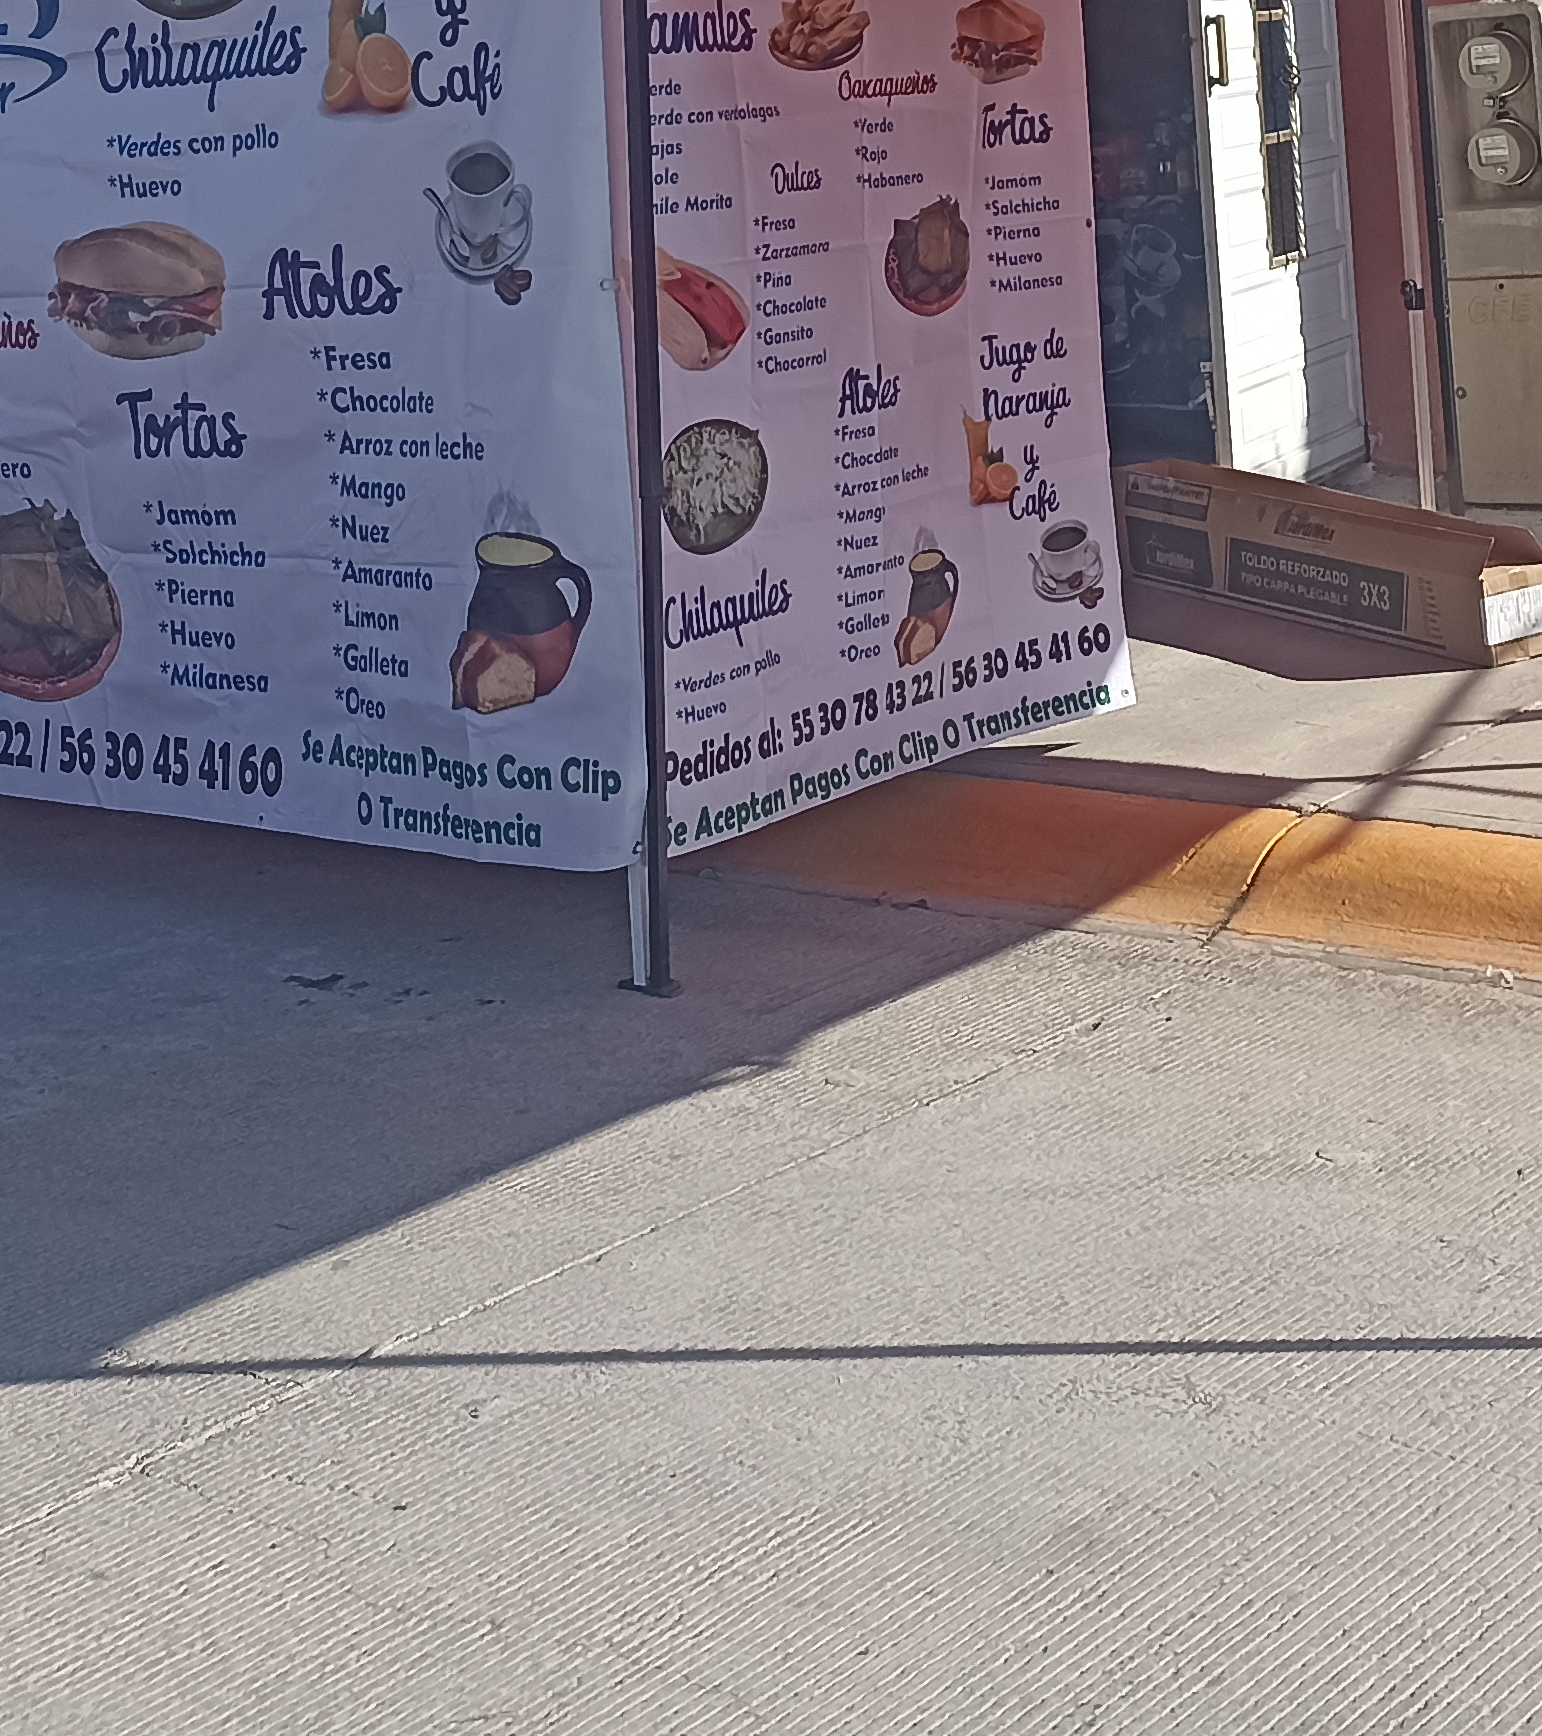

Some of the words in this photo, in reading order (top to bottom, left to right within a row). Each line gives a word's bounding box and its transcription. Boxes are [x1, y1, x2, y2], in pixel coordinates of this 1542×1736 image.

[94, 6, 307, 111] Chilaquiles
[411, 43, 502, 114] Café
[687, 110, 713, 123] con
[981, 103, 1053, 149] Tortas
[188, 134, 225, 153] con
[232, 125, 279, 157] pollo
[771, 162, 822, 194] Dulces
[685, 193, 733, 212] Morita
[262, 244, 402, 320] Atoles
[1468, 295, 1531, 323] CFE
[980, 333, 1037, 383] Jugo
[1043, 328, 1067, 360] de
[838, 364, 901, 418] Atoles
[982, 384, 1071, 428] Naranja
[116, 388, 247, 459] Tortas
[399, 437, 429, 459] con
[435, 433, 485, 461] leche
[1023, 444, 1039, 479] y
[881, 473, 899, 489] con
[901, 463, 929, 483] leche
[1009, 479, 1060, 522] Café
[1241, 551, 1277, 571] TOLDO
[1279, 559, 1349, 587] REFORZADO
[664, 568, 793, 650] Chilaquiles
[1297, 584, 1349, 607] PLEGABLE
[1359, 581, 1390, 611] 3X3
[729, 662, 751, 683] con
[754, 649, 781, 676] pollo
[665, 732, 752, 786] Pedidos
[758, 716, 784, 760] al:
[791, 706, 815, 747] 55
[818, 698, 847, 736] 30
[852, 688, 879, 726] 78
[884, 681, 907, 716] 43
[911, 673, 934, 708] 22
[951, 658, 978, 693] 56
[982, 650, 1009, 684] 30
[1014, 638, 1043, 672] 45
[1048, 631, 1072, 664] 41
[1077, 621, 1112, 657] 60
[60, 725, 96, 775] 56
[104, 731, 144, 780] 30
[153, 734, 189, 787] 45
[199, 740, 231, 791] 41
[238, 745, 283, 797] 60
[302, 730, 324, 762] Se
[329, 734, 417, 776] Aceptan
[422, 746, 488, 788] Pagos
[497, 754, 552, 790] Con
[560, 757, 622, 801] Clip
[694, 787, 786, 841] Aceptan
[789, 762, 851, 805] Pagos
[854, 747, 896, 785] Con
[898, 729, 939, 766] Clip
[941, 718, 962, 749] O
[962, 679, 1112, 743] Transferencia
[358, 792, 373, 825] O
[380, 797, 542, 847] Transferencia
